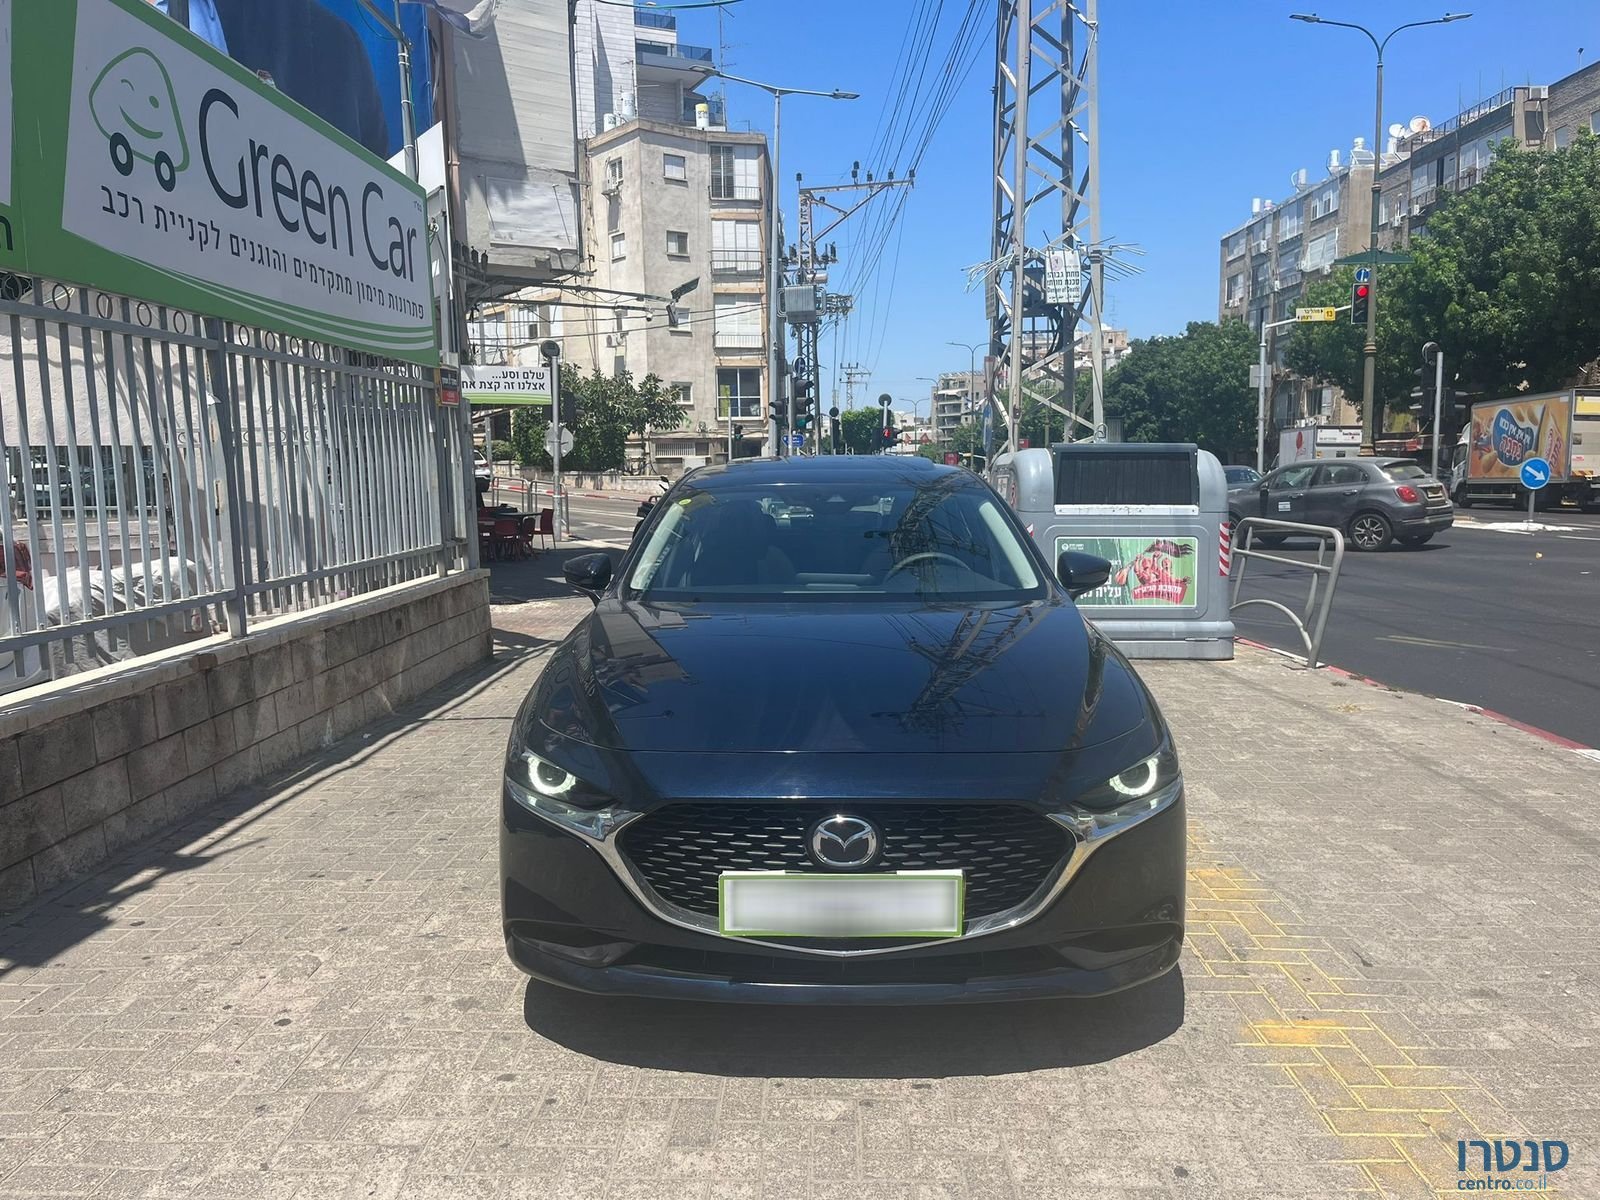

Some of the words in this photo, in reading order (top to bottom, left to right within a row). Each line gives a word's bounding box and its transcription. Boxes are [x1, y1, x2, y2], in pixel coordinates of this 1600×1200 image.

[199, 88, 354, 257] Green
[362, 181, 417, 282] Car
[101, 185, 144, 224] רכב
[153, 204, 221, 252] לקניית
[229, 233, 288, 273] והוגנים
[293, 257, 353, 296] מתקדמים
[356, 280, 385, 305] מימון
[387, 292, 424, 320] פתרונות
[479, 380, 501, 392] קצת
[504, 381, 515, 390] זה
[518, 381, 546, 391] אצלנו
[523, 369, 545, 380] שלם
